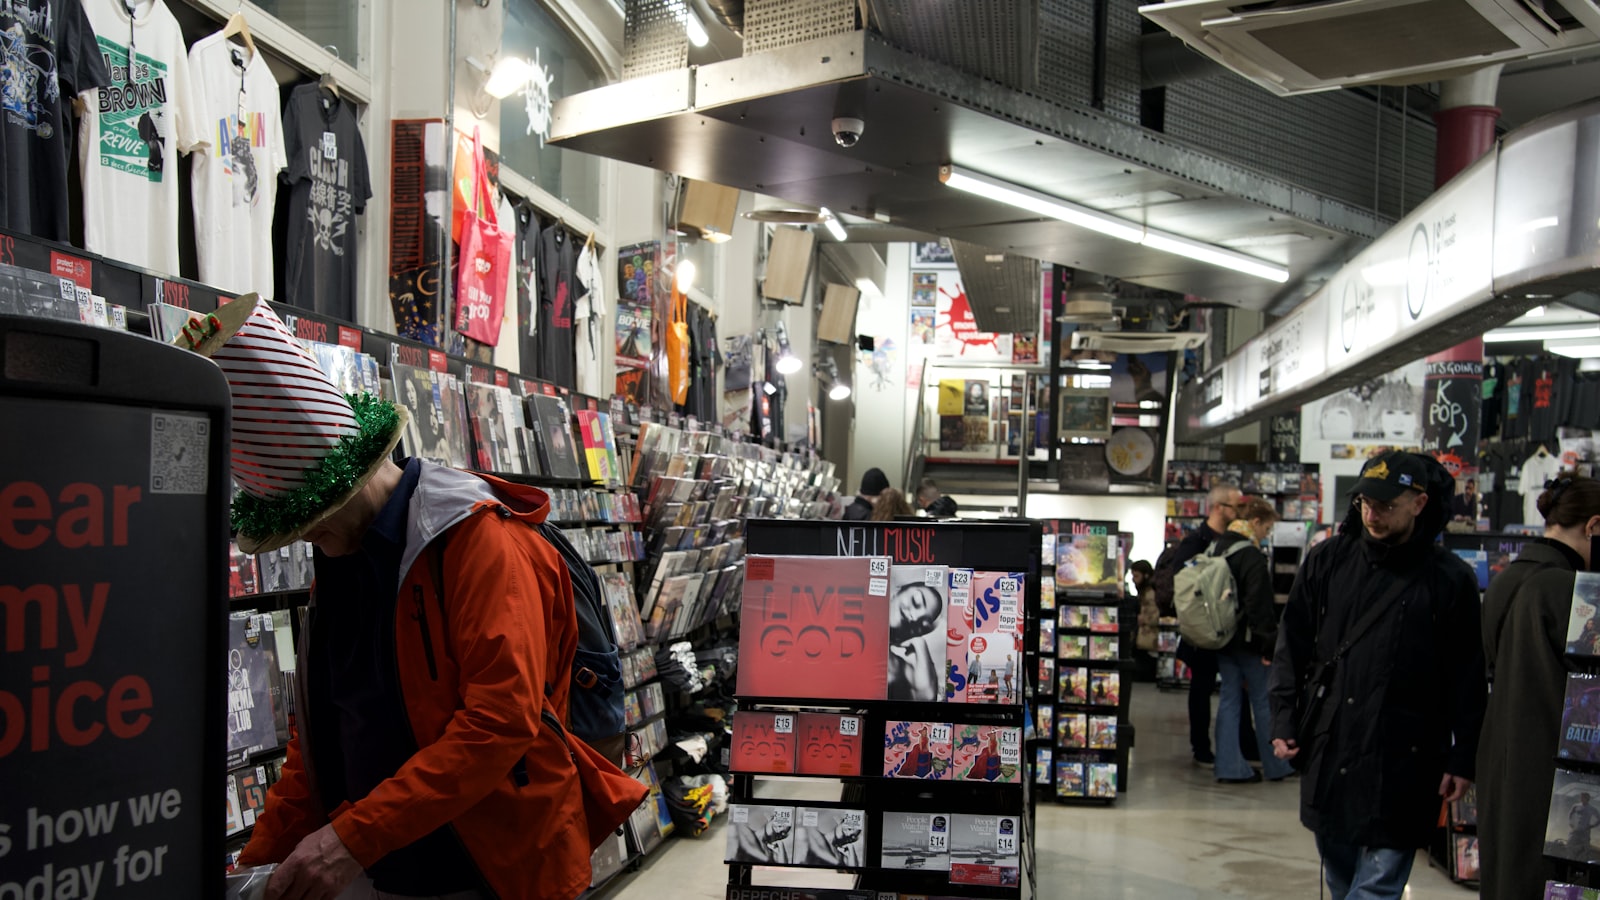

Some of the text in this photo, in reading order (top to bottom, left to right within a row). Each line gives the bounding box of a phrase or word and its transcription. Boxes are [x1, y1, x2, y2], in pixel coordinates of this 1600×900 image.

[98, 77, 167, 113] BROWN
[100, 130, 144, 155] REVUE
[310, 146, 349, 188] CLASH
[618, 313, 651, 329] BOWIE
[1436, 380, 1452, 405] K
[1430, 403, 1462, 427] POP
[883, 527, 935, 563] MUSIC
[871, 561, 885, 572] £45
[954, 573, 968, 584] £23
[1001, 581, 1015, 592] £25
[762, 585, 865, 623] LIVE
[1000, 615, 1016, 625] fopp
[760, 625, 865, 659] GOD
[775, 718, 790, 729] £15
[841, 719, 856, 731] £15
[932, 728, 947, 739] £11
[1002, 732, 1017, 743] £11
[1566, 726, 1600, 743] BALLE
[1002, 747, 1018, 757] fopp
[27, 803, 118, 851] how
[128, 787, 183, 825] we
[906, 815, 928, 824] People
[901, 823, 930, 832] Watchin
[969, 825, 997, 833] Watchin
[930, 836, 945, 847] £14
[998, 838, 1013, 849] £14
[114, 844, 168, 887] for
